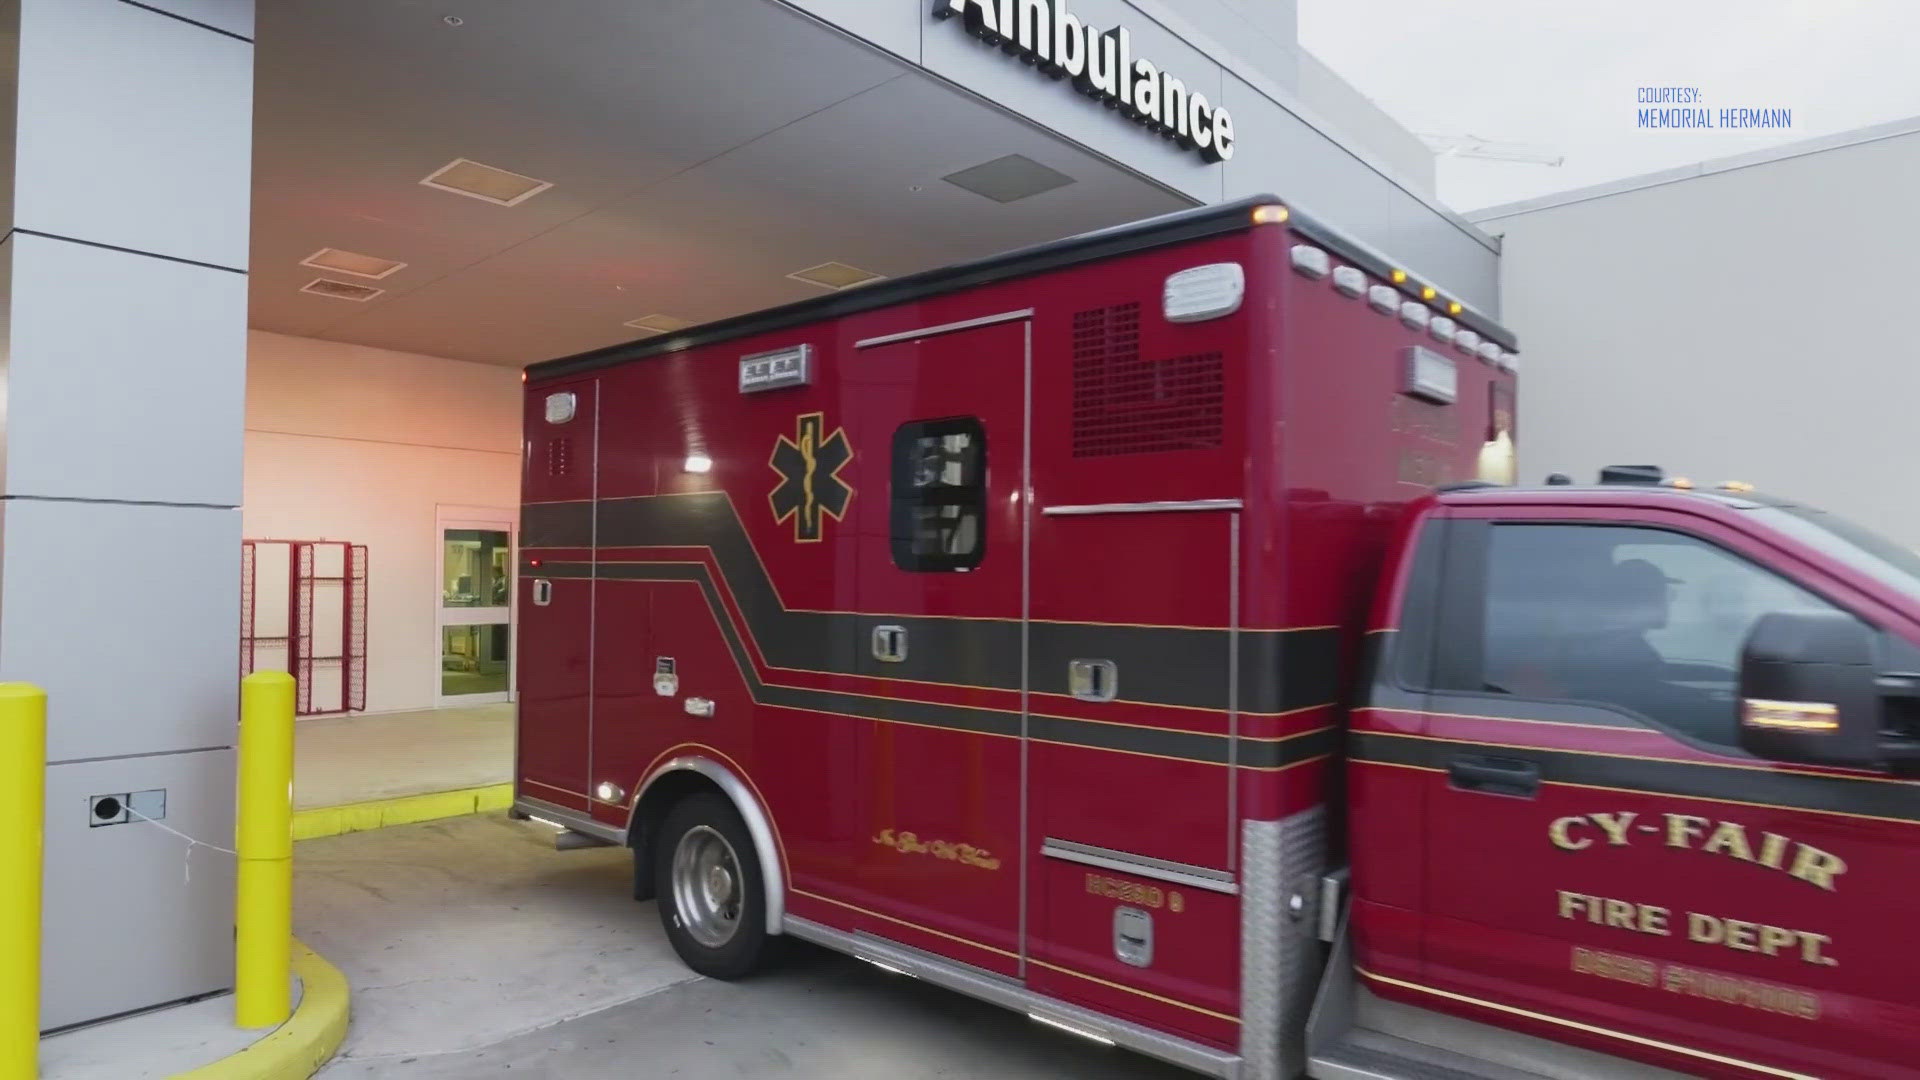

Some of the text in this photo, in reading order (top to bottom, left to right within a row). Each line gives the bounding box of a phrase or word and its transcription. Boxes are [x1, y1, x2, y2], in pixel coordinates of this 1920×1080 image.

[1549, 811, 1849, 892] CY-FAIR
[1556, 889, 1840, 967] FIRE DEPT.
